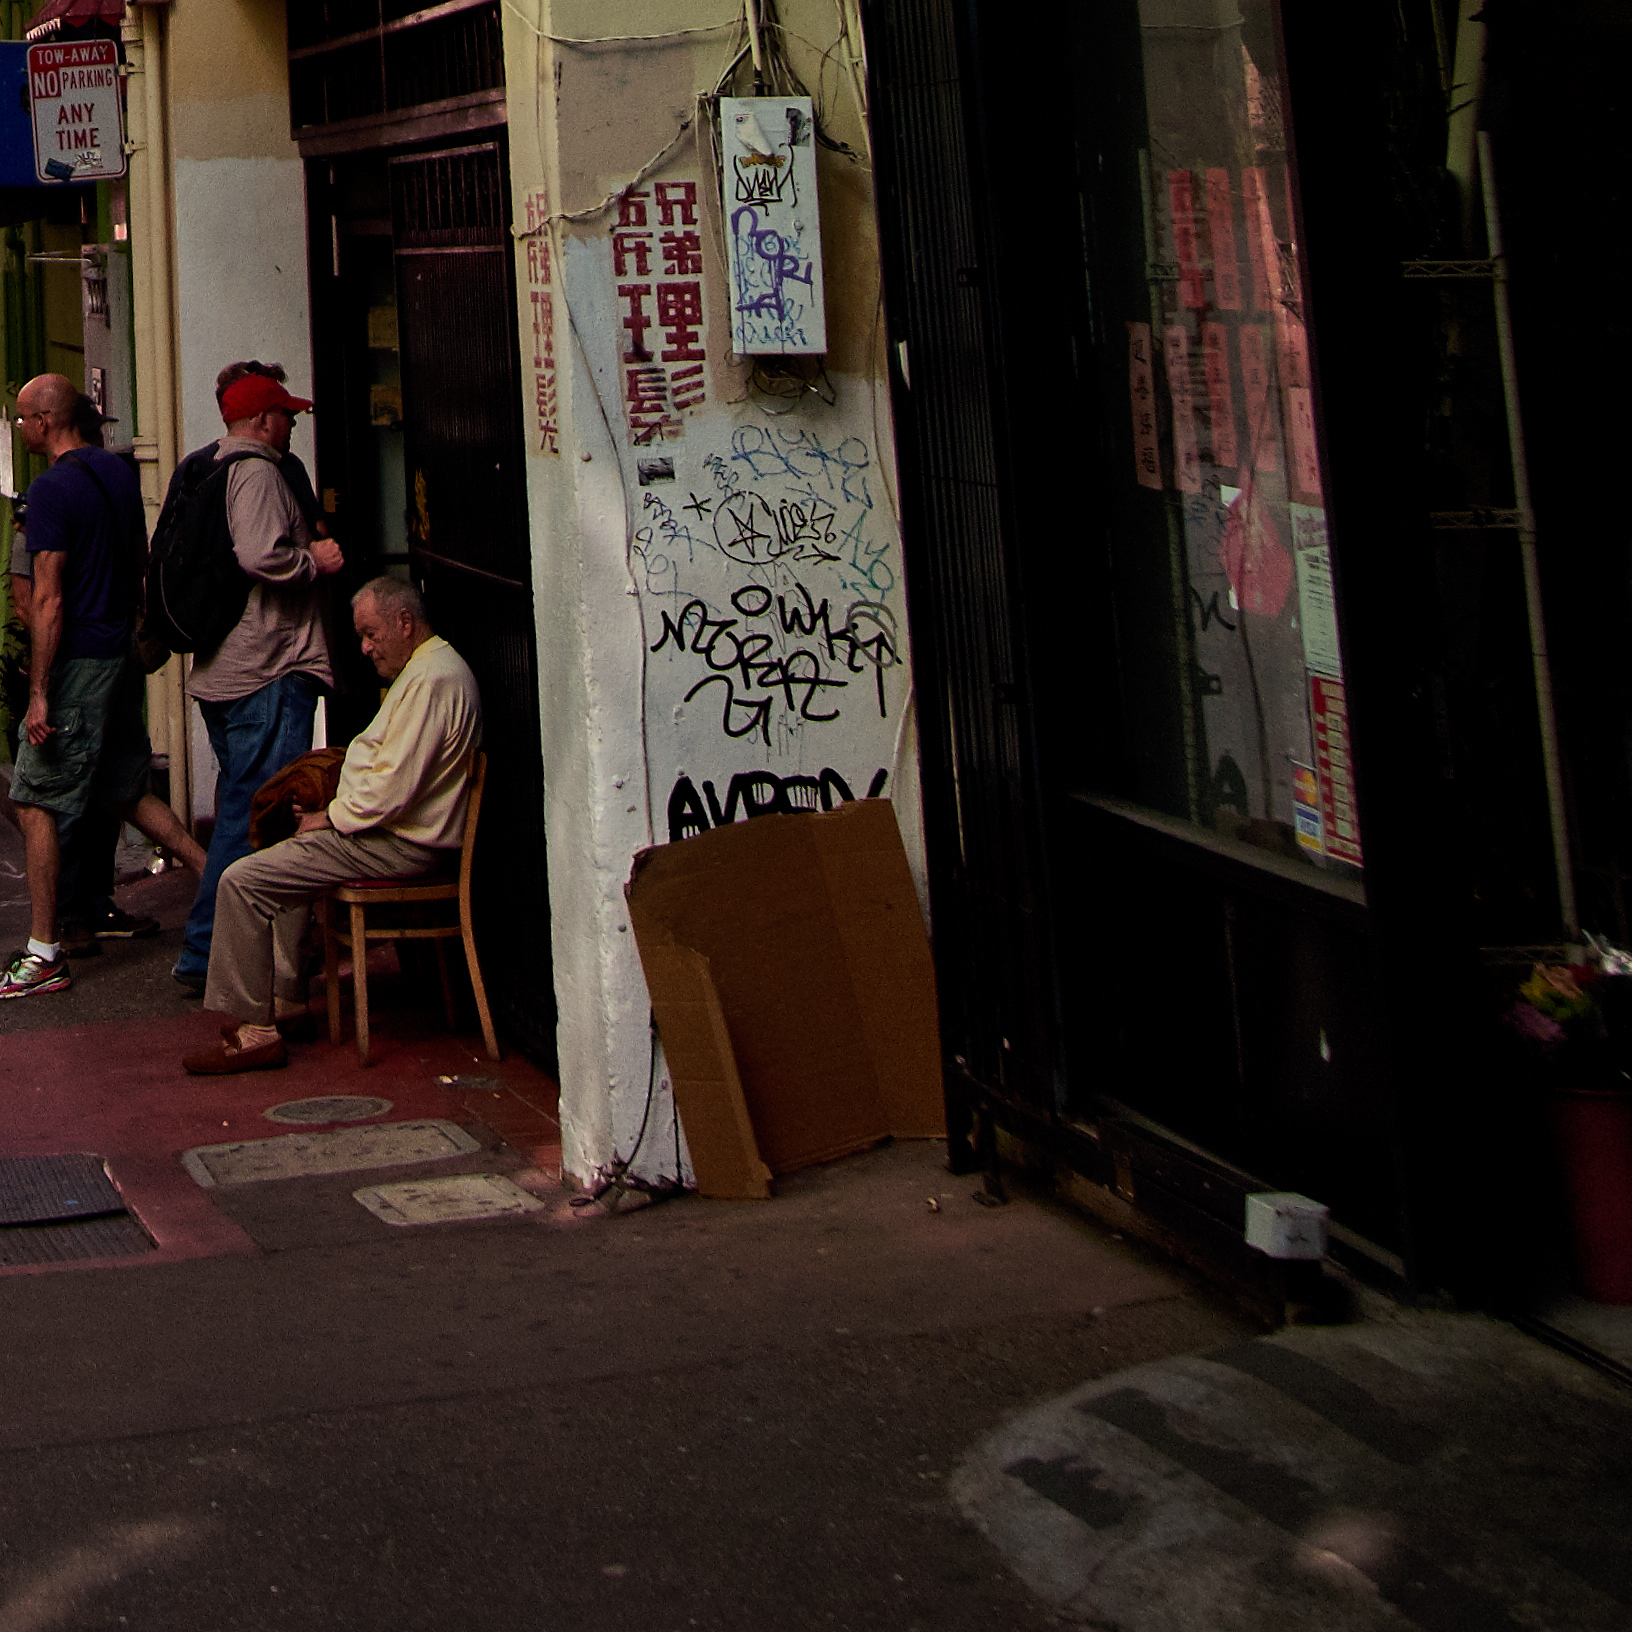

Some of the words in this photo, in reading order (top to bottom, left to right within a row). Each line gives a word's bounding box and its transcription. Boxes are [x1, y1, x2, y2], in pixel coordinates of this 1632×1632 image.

[37, 45, 108, 65] TOW-AWAY
[33, 70, 59, 98] NO
[62, 68, 113, 90] PARKING
[58, 102, 95, 125] ANY
[55, 127, 101, 151] TIME
